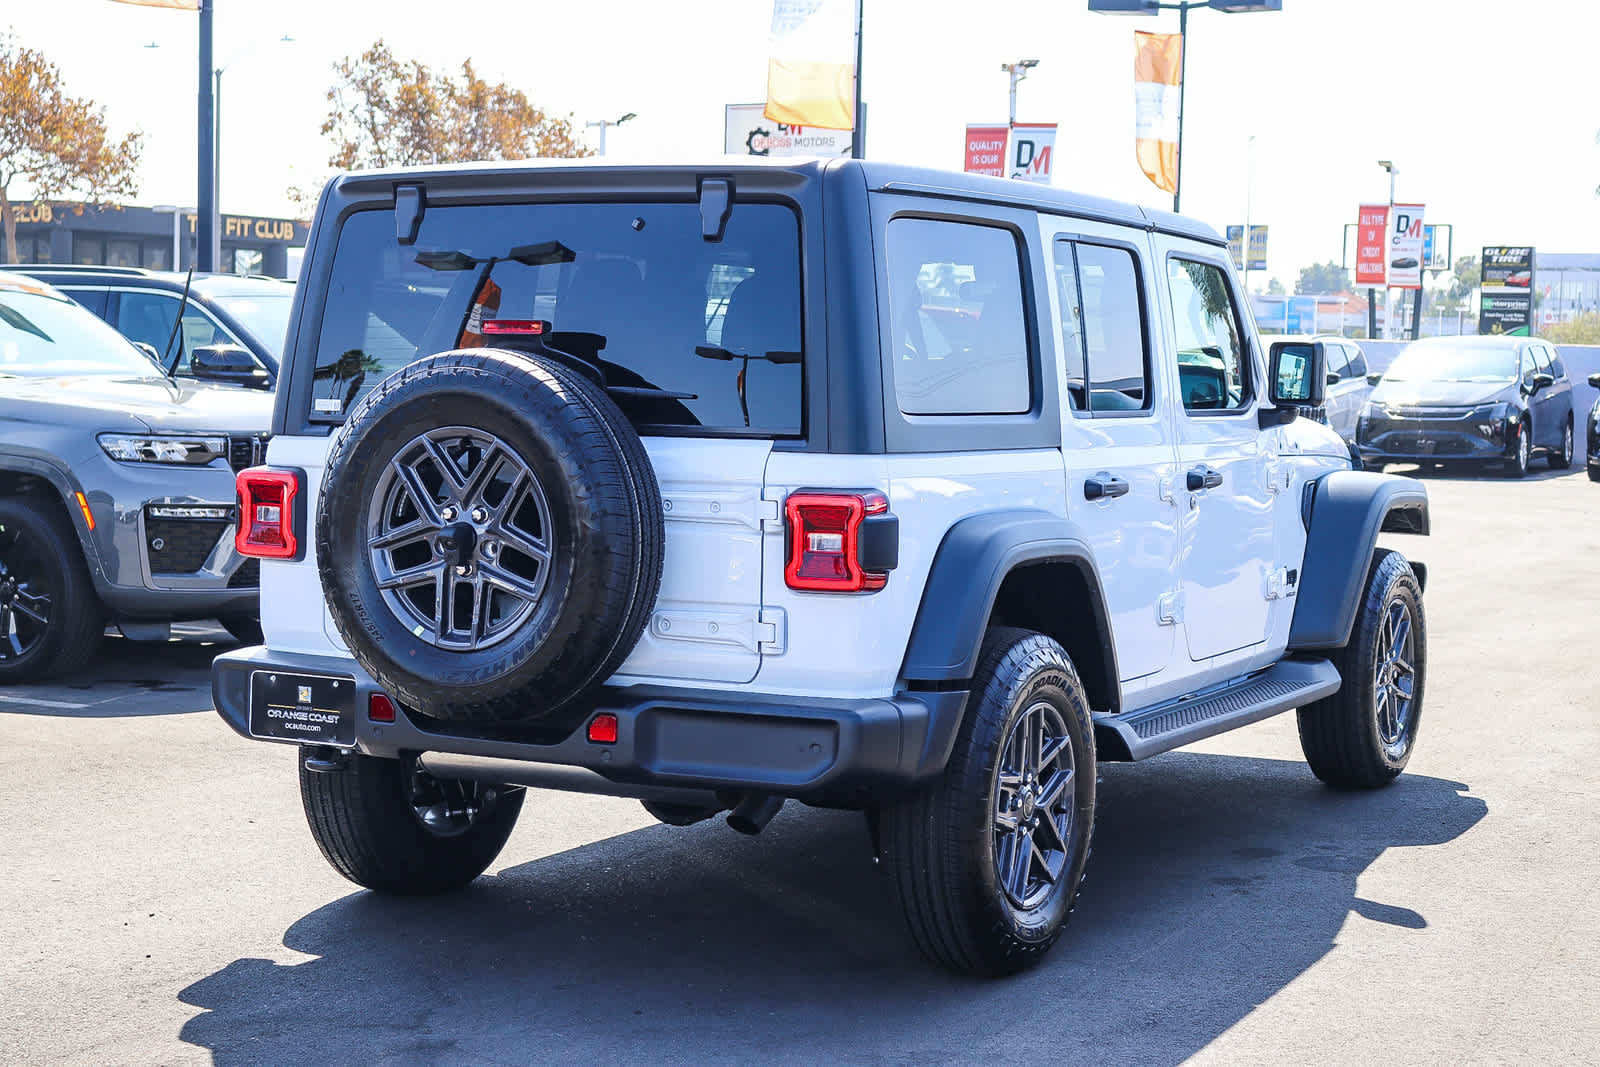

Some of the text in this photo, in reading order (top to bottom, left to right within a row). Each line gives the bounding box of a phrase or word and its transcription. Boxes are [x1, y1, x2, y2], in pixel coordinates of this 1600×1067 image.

[793, 136, 836, 147] MOTORS
[969, 141, 1004, 151] QUALITY
[972, 155, 999, 165] IS OUR
[226, 217, 294, 240] FIT CLUB
[267, 709, 340, 725] ORANGE COAST
[284, 722, 321, 733] ocauto.com
